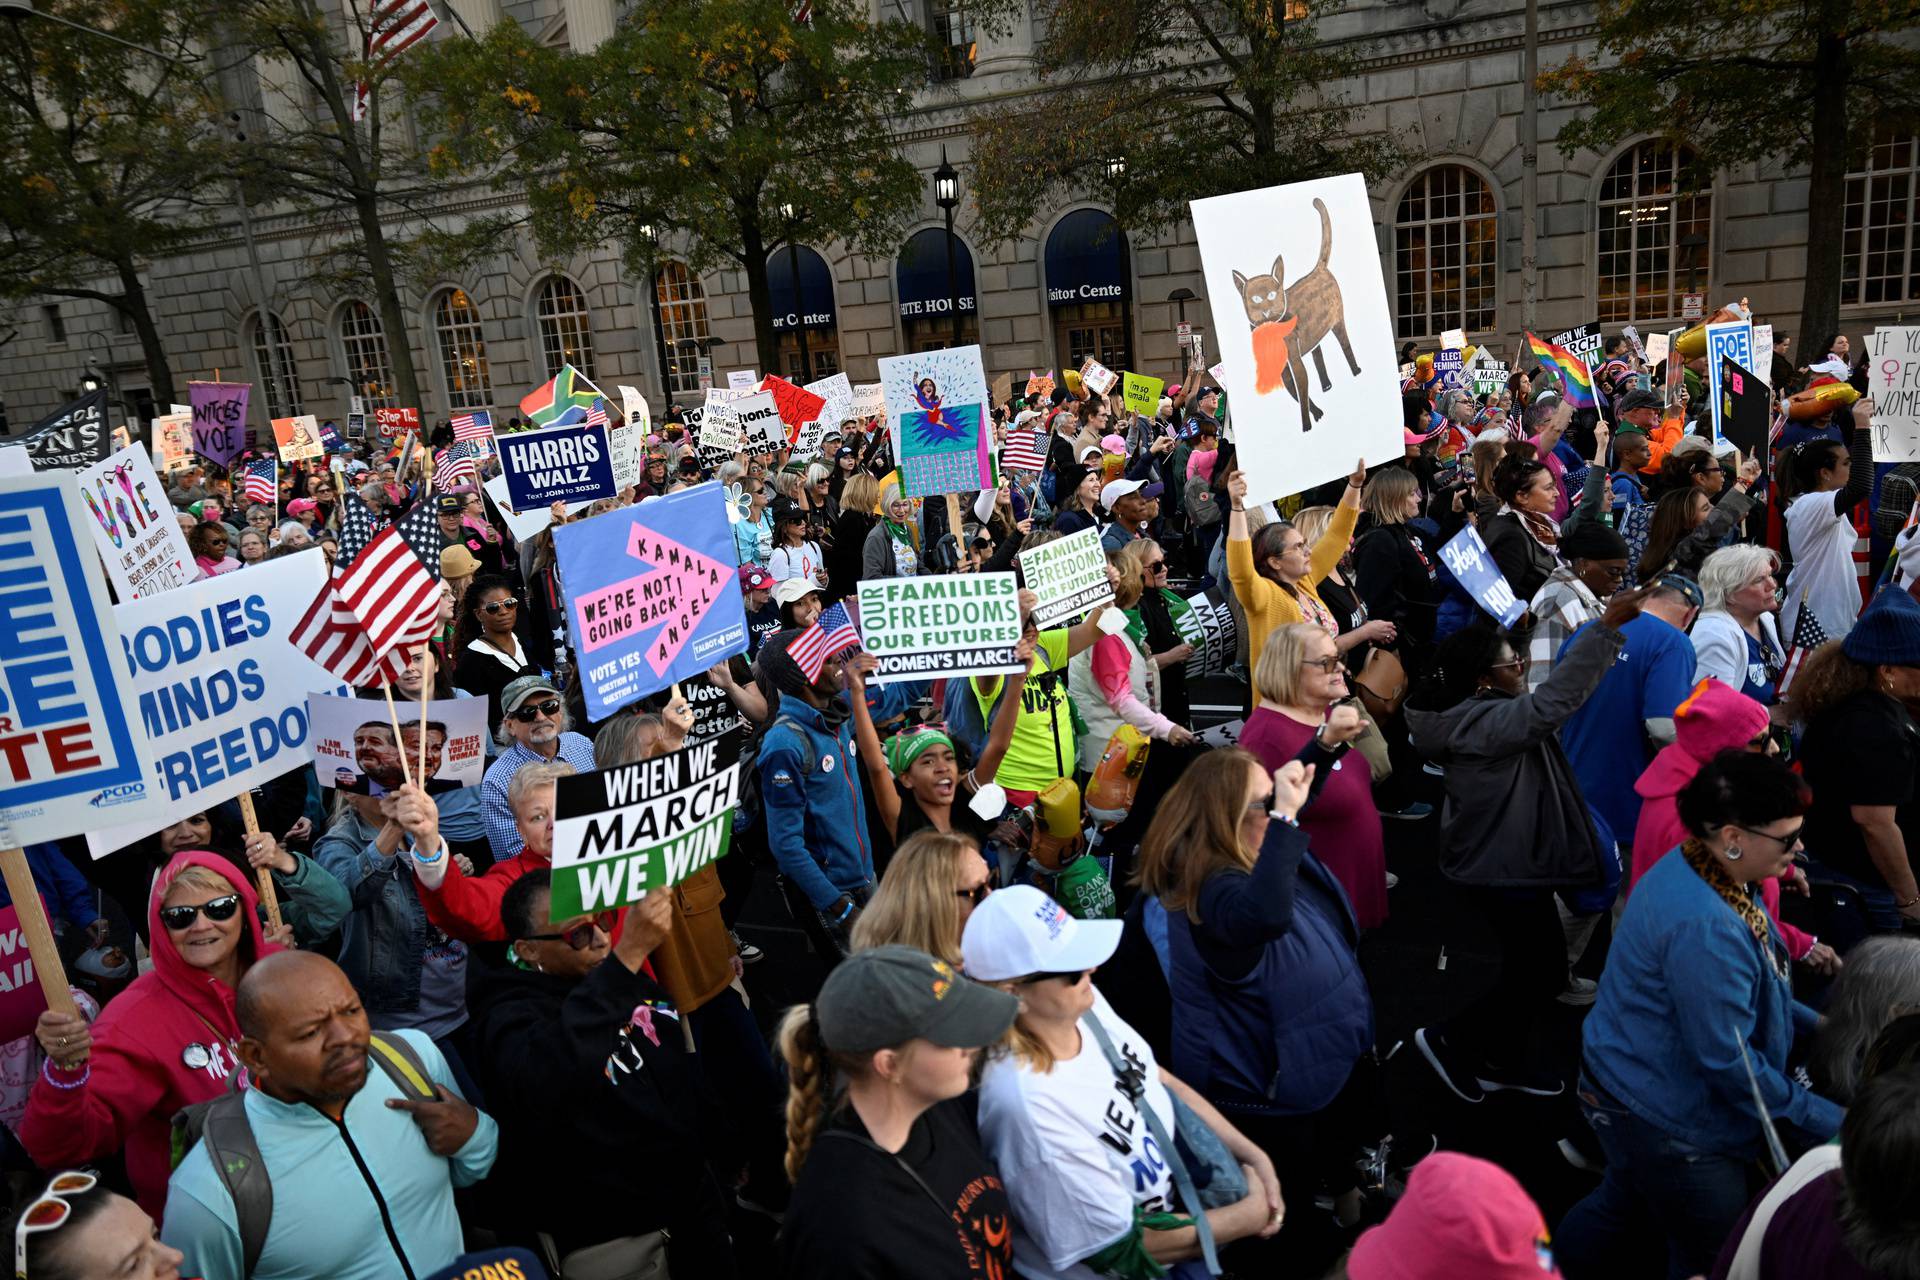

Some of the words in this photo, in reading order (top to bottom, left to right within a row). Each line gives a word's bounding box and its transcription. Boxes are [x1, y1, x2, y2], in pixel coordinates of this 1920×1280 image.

[1048, 287, 1076, 301] isitor
[1080, 284, 1122, 298] Cente
[1552, 332, 1573, 346] WHEN
[1574, 326, 1587, 339] WE
[1562, 336, 1599, 355] ARCH
[1715, 332, 1747, 361] ROE
[1874, 331, 1891, 356] IF
[1441, 351, 1462, 361] ELECT
[377, 409, 401, 426] Stop
[808, 422, 822, 431] We
[509, 434, 600, 474] HARRIS
[806, 437, 818, 447] go
[528, 465, 591, 490] WALZ
[614, 468, 631, 481] EADERS
[525, 492, 542, 501] Text
[544, 489, 565, 498] JOIN
[566, 487, 574, 495] to
[575, 483, 601, 493] 30330
[637, 538, 719, 586] KAMALA
[1022, 554, 1040, 590] OUR
[1033, 531, 1099, 566] FAMILIES
[1037, 547, 1105, 587] FREEDOMS
[1038, 587, 1058, 602] UR
[1060, 566, 1107, 593] FUTURES
[584, 588, 636, 623] WE'RE
[862, 586, 887, 631] OUR
[886, 577, 1015, 603] FAMILIES
[888, 599, 1018, 630] FREEDOMS
[1035, 595, 1082, 622] WOMEN'S
[1080, 582, 1112, 608] MARCH
[589, 613, 632, 643] GOING
[865, 633, 915, 651] OUR
[922, 626, 1019, 647] FUTURES
[1194, 604, 1223, 674] MARCH
[695, 638, 718, 654] TALBOT
[589, 660, 618, 684] VOTE
[619, 651, 641, 670] YES
[876, 652, 955, 674] WOMEN'S
[957, 648, 1020, 667] MARCH
[598, 675, 628, 695] QUESTION
[602, 685, 632, 706] QUESTION
[155, 688, 346, 801] REEDO
[450, 734, 480, 748] UNLESS
[603, 753, 681, 808] WHEN
[687, 739, 720, 784] WE
[103, 782, 145, 800] PCDO
[577, 768, 733, 860] MARCH
[577, 852, 649, 912] WE
[662, 815, 726, 888] WIN
[1076, 873, 1105, 898] BANS
